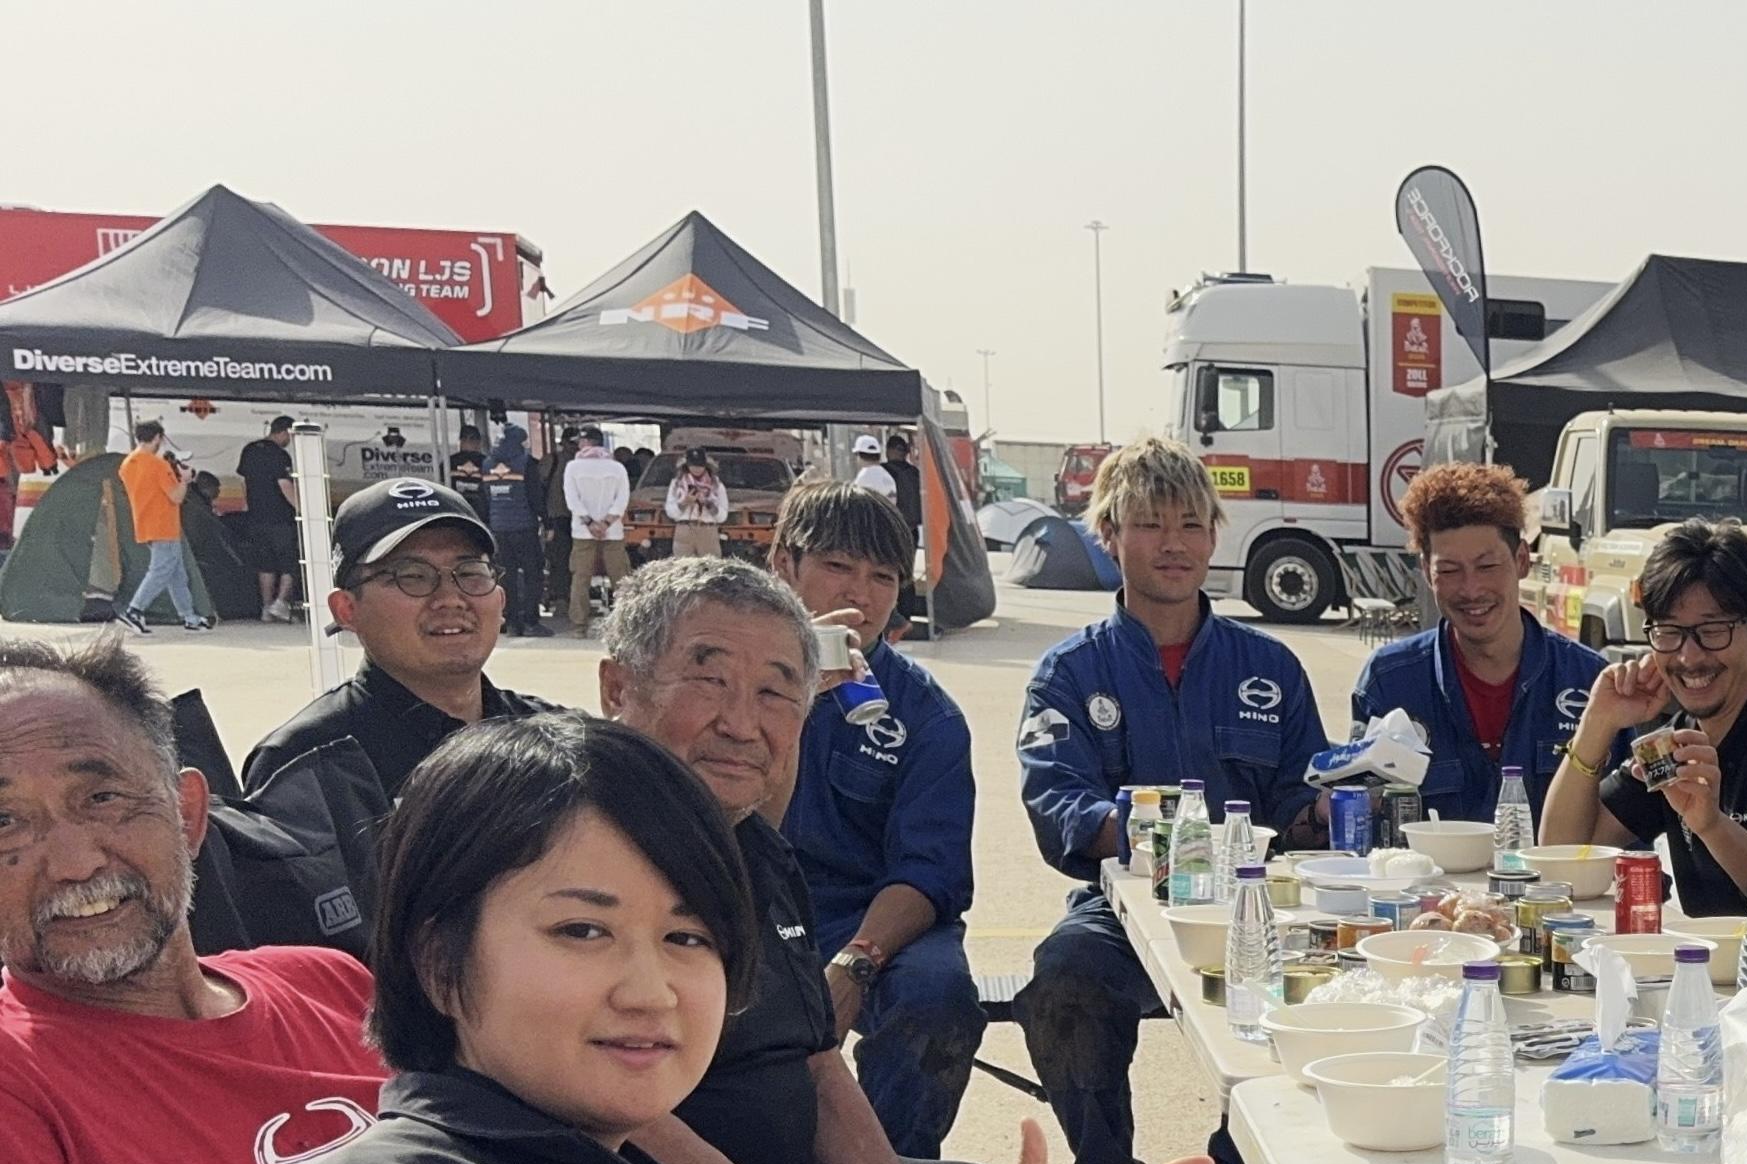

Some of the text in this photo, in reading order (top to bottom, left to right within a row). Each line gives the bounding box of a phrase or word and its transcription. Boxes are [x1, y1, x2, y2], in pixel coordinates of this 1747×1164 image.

[418, 260, 471, 281] LJS
[420, 284, 469, 299] TEAM
[13, 348, 333, 382] DiverseExtremeTeam.com
[361, 447, 433, 464] Diverse
[1212, 472, 1245, 486] 1658
[397, 500, 440, 509] HINO
[1239, 711, 1279, 723] HINO
[859, 744, 899, 765] HINO
